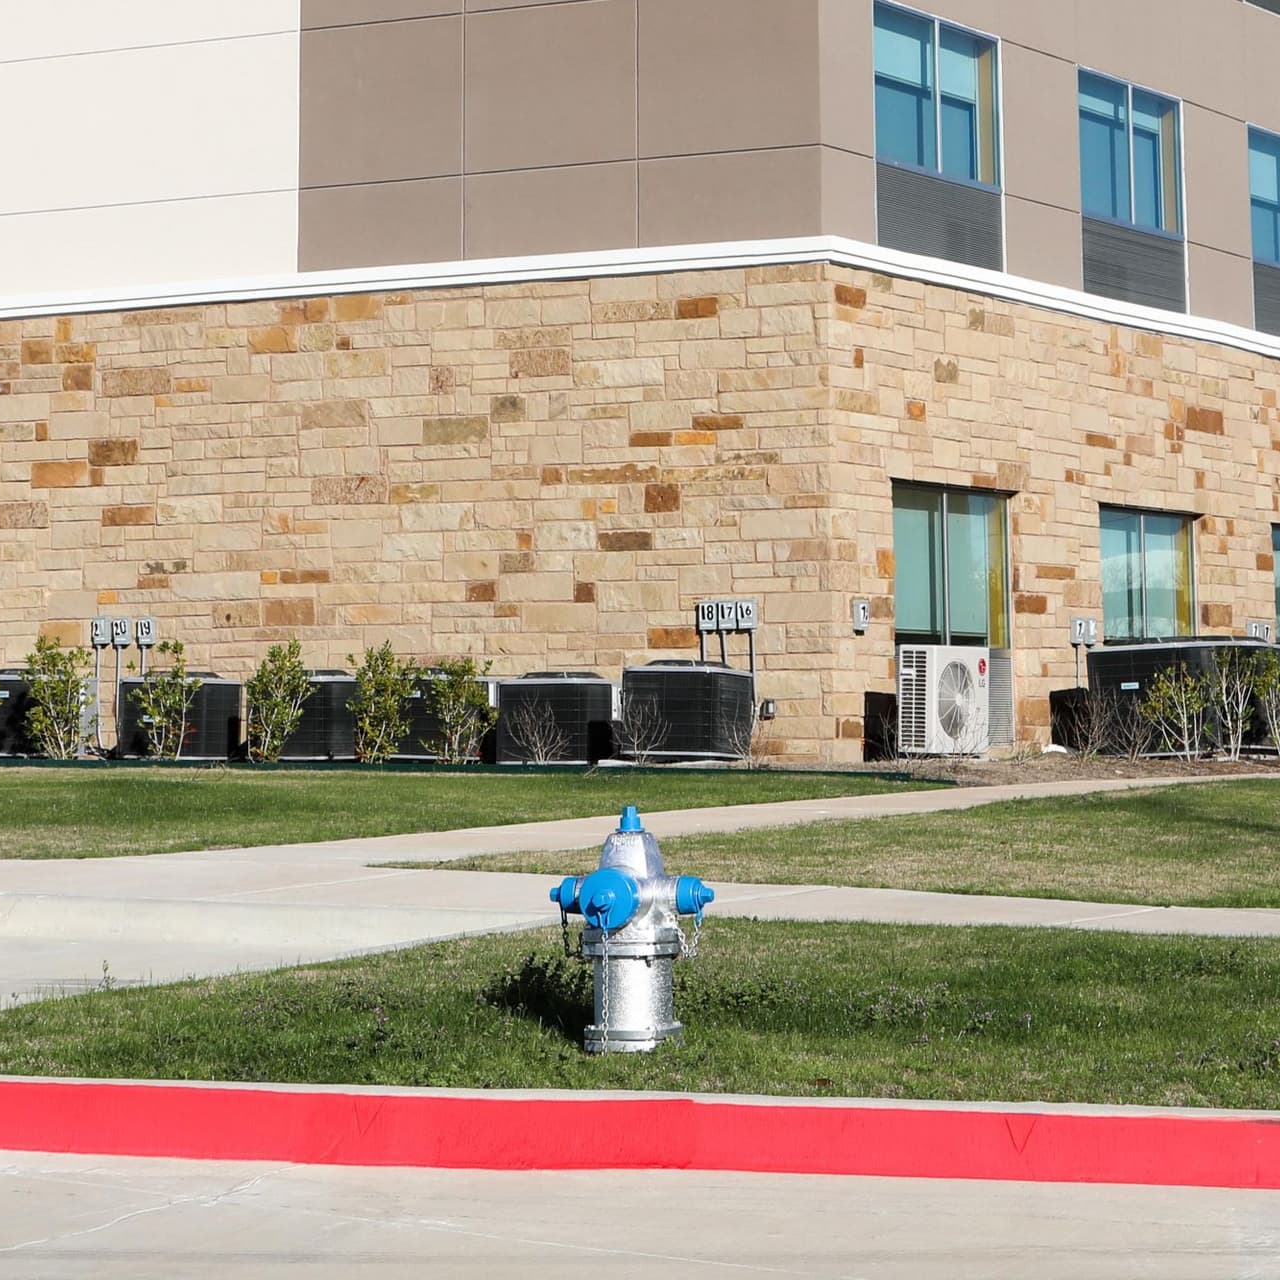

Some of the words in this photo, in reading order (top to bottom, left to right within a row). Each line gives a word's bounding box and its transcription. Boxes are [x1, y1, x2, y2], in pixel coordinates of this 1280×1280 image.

[701, 604, 714, 621] 18
[720, 604, 733, 620] 17
[739, 603, 752, 619] 16
[114, 621, 127, 636] 20
[139, 620, 151, 636] 19
